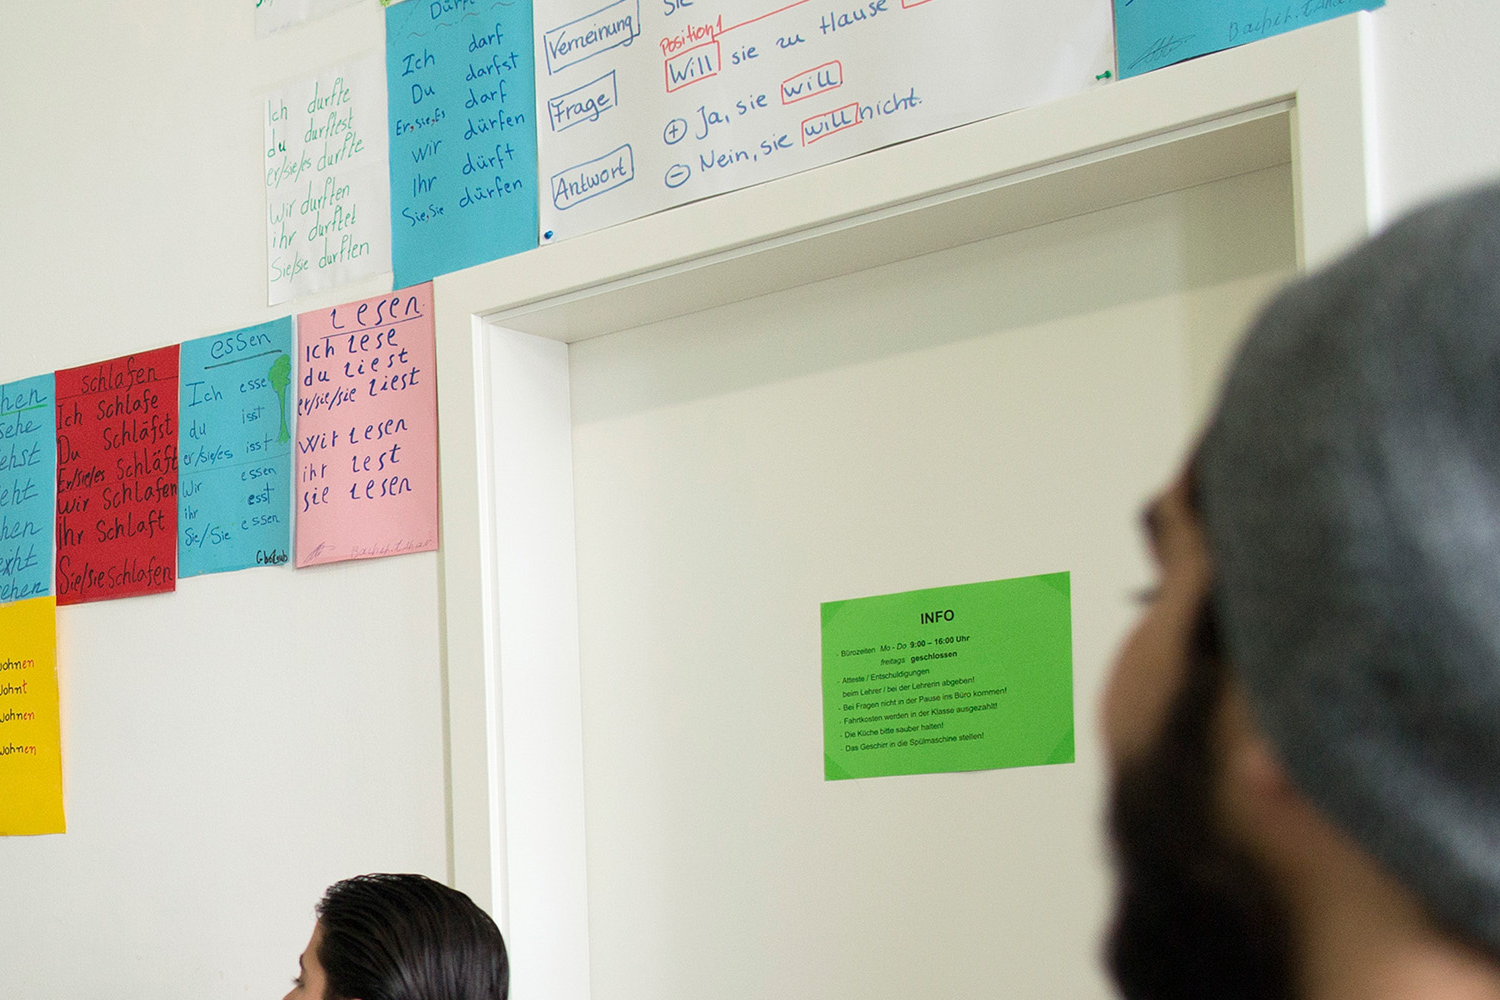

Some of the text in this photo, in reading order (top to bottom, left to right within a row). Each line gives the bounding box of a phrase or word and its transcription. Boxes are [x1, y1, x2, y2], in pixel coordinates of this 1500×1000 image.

[402, 24, 504, 76] Ich darf
[660, 23, 714, 56] Position
[669, 0, 888, 83] Will sie zu Hause
[411, 52, 518, 104] Du darfst
[465, 80, 508, 109] darf
[551, 94, 610, 122] Frage
[737, 94, 768, 115] sie
[464, 110, 525, 140] dürfen
[761, 135, 794, 155] sie
[805, 112, 850, 136] will
[462, 143, 515, 175] dürft
[459, 177, 522, 208] dürfen
[555, 157, 626, 200] Antwort
[306, 338, 335, 362] Ich
[304, 368, 330, 386] du
[58, 403, 83, 430] Ich
[920, 610, 954, 624] INFO
[910, 640, 926, 648] 9:00
[935, 637, 954, 645] 16:00
[956, 635, 970, 643] Uhr
[911, 651, 957, 663] geschlossen
